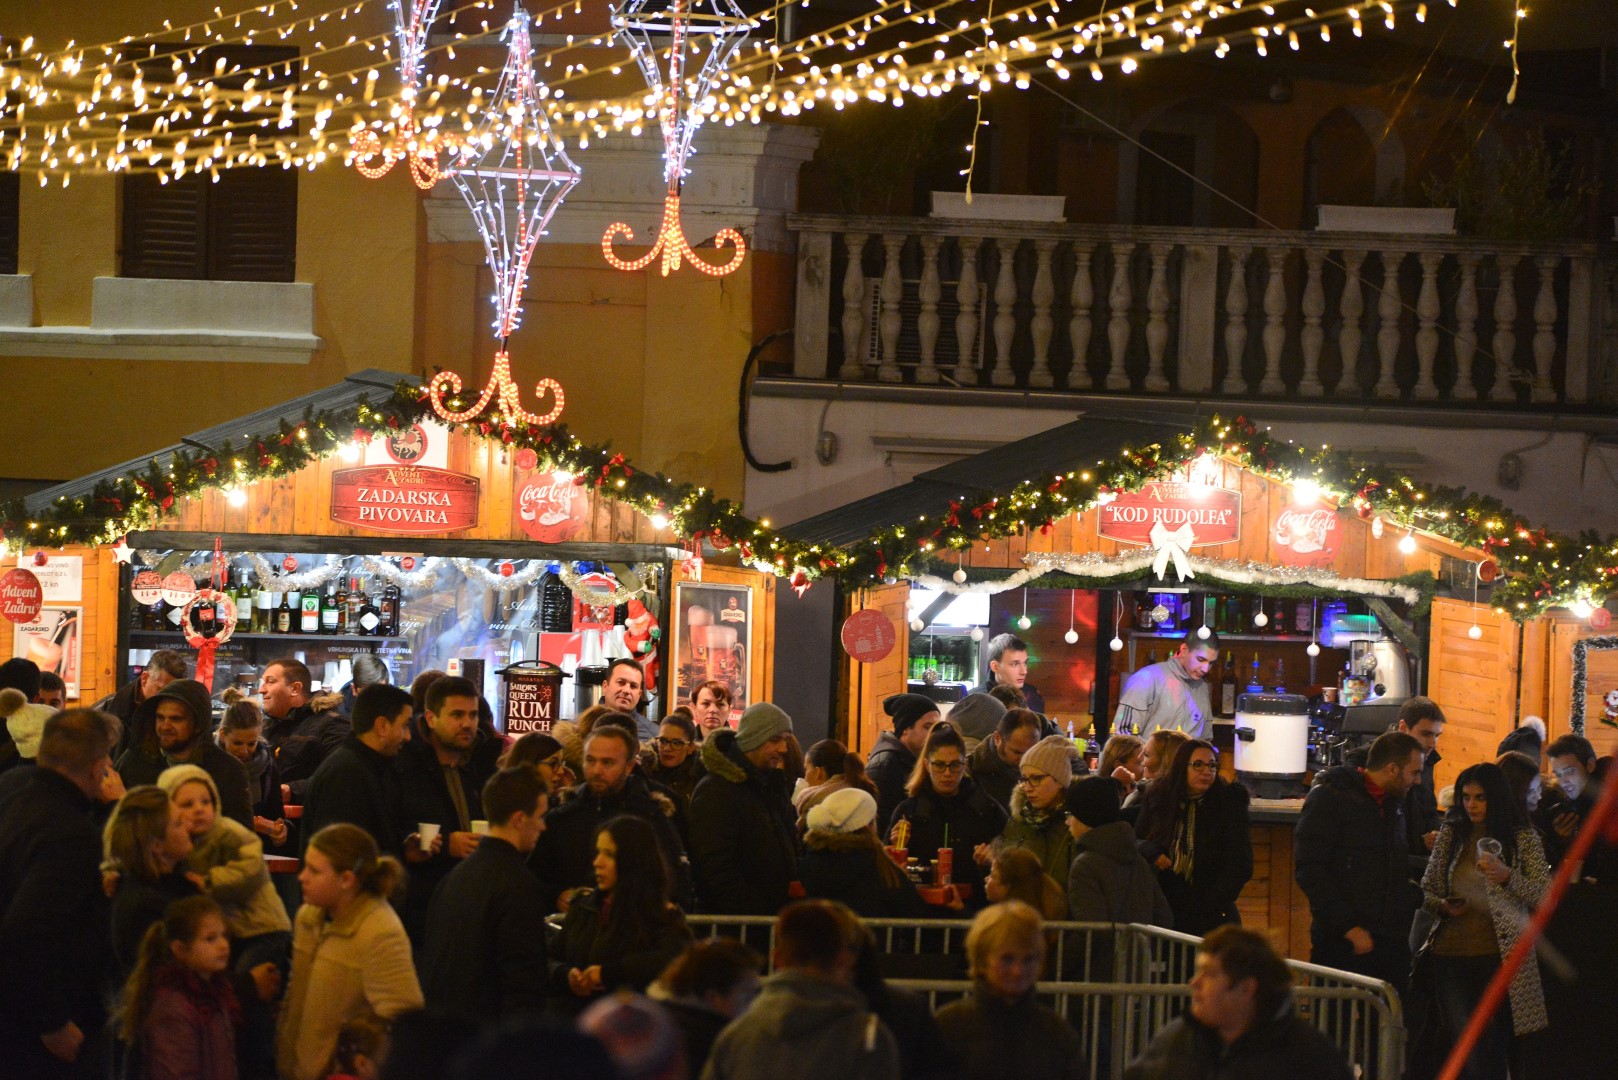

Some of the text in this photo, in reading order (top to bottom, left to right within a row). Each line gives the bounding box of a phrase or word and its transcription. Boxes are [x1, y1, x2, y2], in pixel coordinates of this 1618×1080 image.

[357, 488, 452, 506] ZADARSKA
[519, 482, 579, 506] Coca-Cola
[359, 506, 449, 524] PIVOVARA
[1106, 506, 1232, 526] “KOD RUDOLFA”
[1277, 509, 1336, 531] Coca-Cola
[2, 585, 37, 599] Advent
[4, 601, 36, 614] Zadru
[17, 597, 22, 605] u
[510, 682, 538, 692] SAILOR'S
[509, 691, 538, 701] QUEEN
[508, 700, 551, 719] RUM
[507, 719, 551, 732] PUNCH
